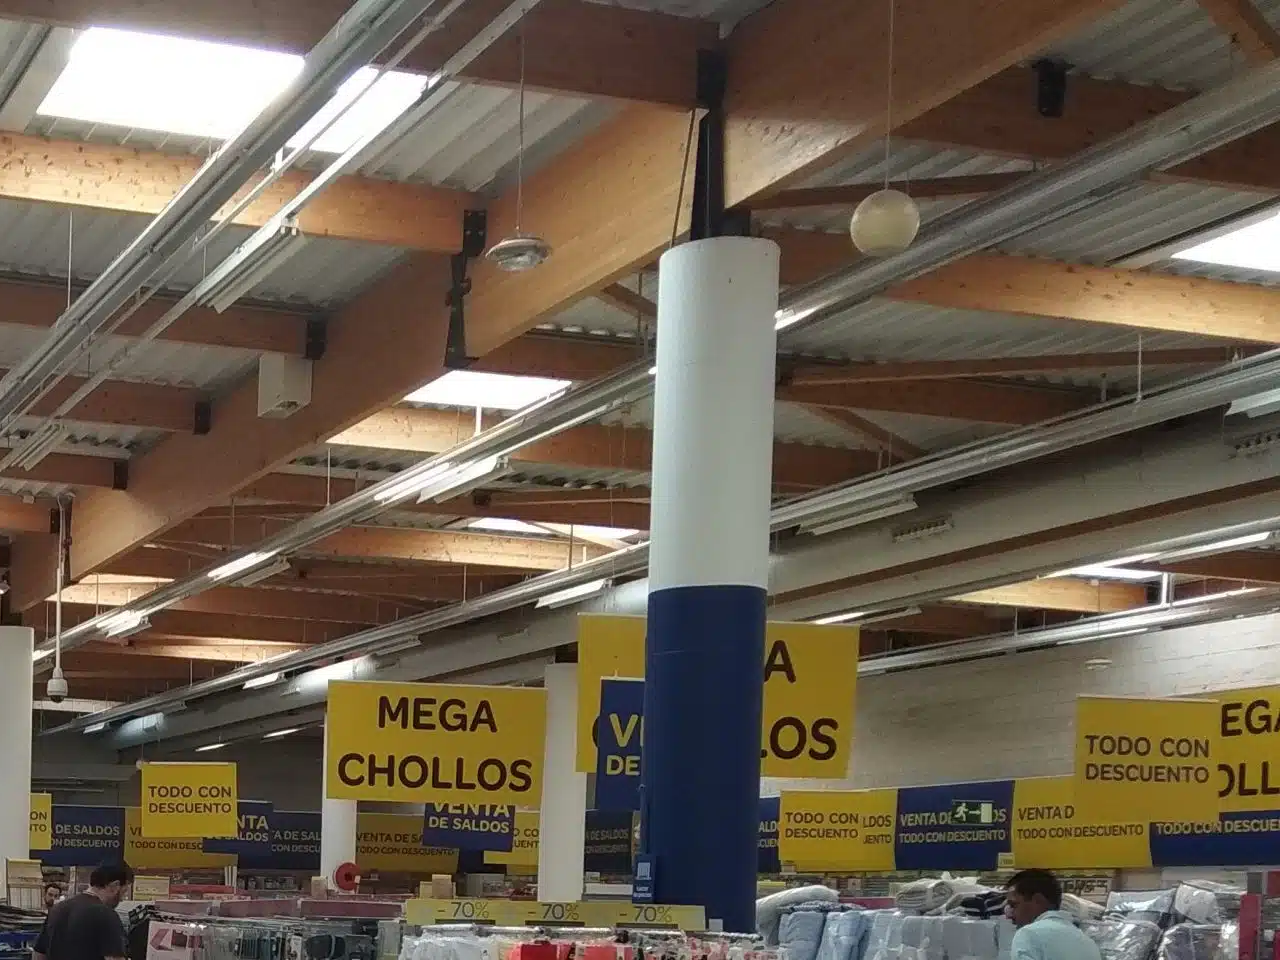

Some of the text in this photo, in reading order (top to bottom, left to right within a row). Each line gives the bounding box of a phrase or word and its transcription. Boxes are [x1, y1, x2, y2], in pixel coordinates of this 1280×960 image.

[377, 695, 498, 733] MEGA
[1085, 734, 1210, 758] TODO CON
[337, 752, 533, 792] CHOLLOS
[606, 754, 640, 776] DE
[1085, 762, 1210, 784] DESCUENTO
[148, 785, 232, 798] TODO CON
[148, 802, 232, 814] DESCUENTO
[432, 802, 511, 818] VENTA
[1018, 805, 1064, 821] VENTA
[785, 811, 859, 824] TODO CON
[900, 813, 937, 827] VENTA
[55, 823, 72, 834] DE
[73, 824, 120, 836] SALDOS
[428, 816, 449, 829] DE
[452, 818, 510, 834] SALDOS
[1017, 823, 1144, 840] TODO CON DESCUENTO
[1155, 821, 1192, 835] TODO
[1193, 820, 1222, 834] CON
[283, 830, 300, 840] DE
[356, 832, 393, 844] VENTA
[395, 833, 410, 844] DE
[784, 827, 859, 839] DESCUENTO
[899, 829, 1006, 844] TODO CON DESCUENTO
[63, 838, 120, 848] DESCUENTO
[129, 840, 156, 849] TODO
[157, 841, 179, 850] CON
[271, 843, 291, 852] CON
[380, 846, 400, 855] CON
[401, 847, 455, 857] DESCUENTO
